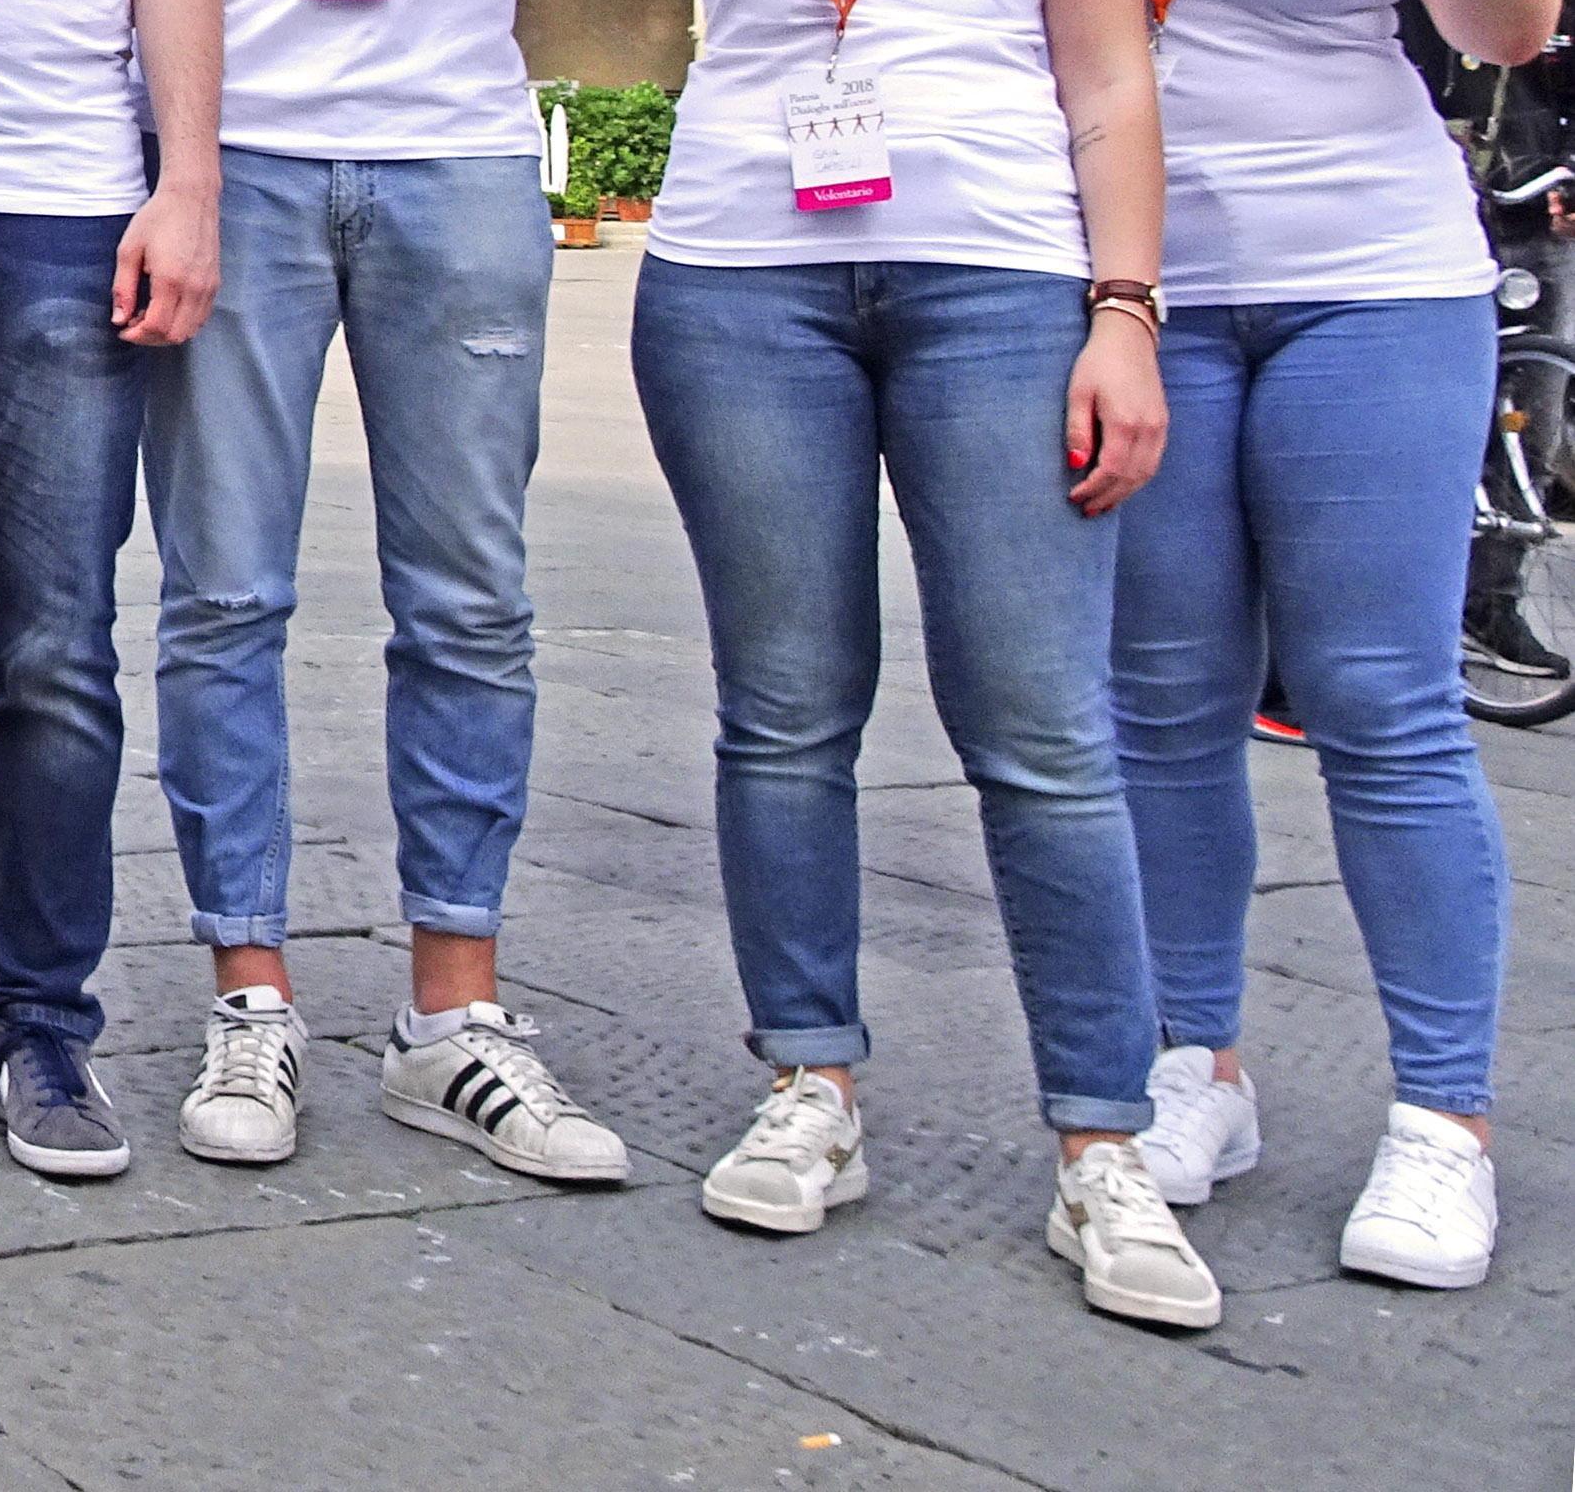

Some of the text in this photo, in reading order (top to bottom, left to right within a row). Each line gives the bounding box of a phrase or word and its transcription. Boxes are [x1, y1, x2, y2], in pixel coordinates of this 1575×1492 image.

[842, 78, 874, 96] 2018
[791, 103, 830, 116] Dialoghi
[813, 186, 874, 202] Volontario
